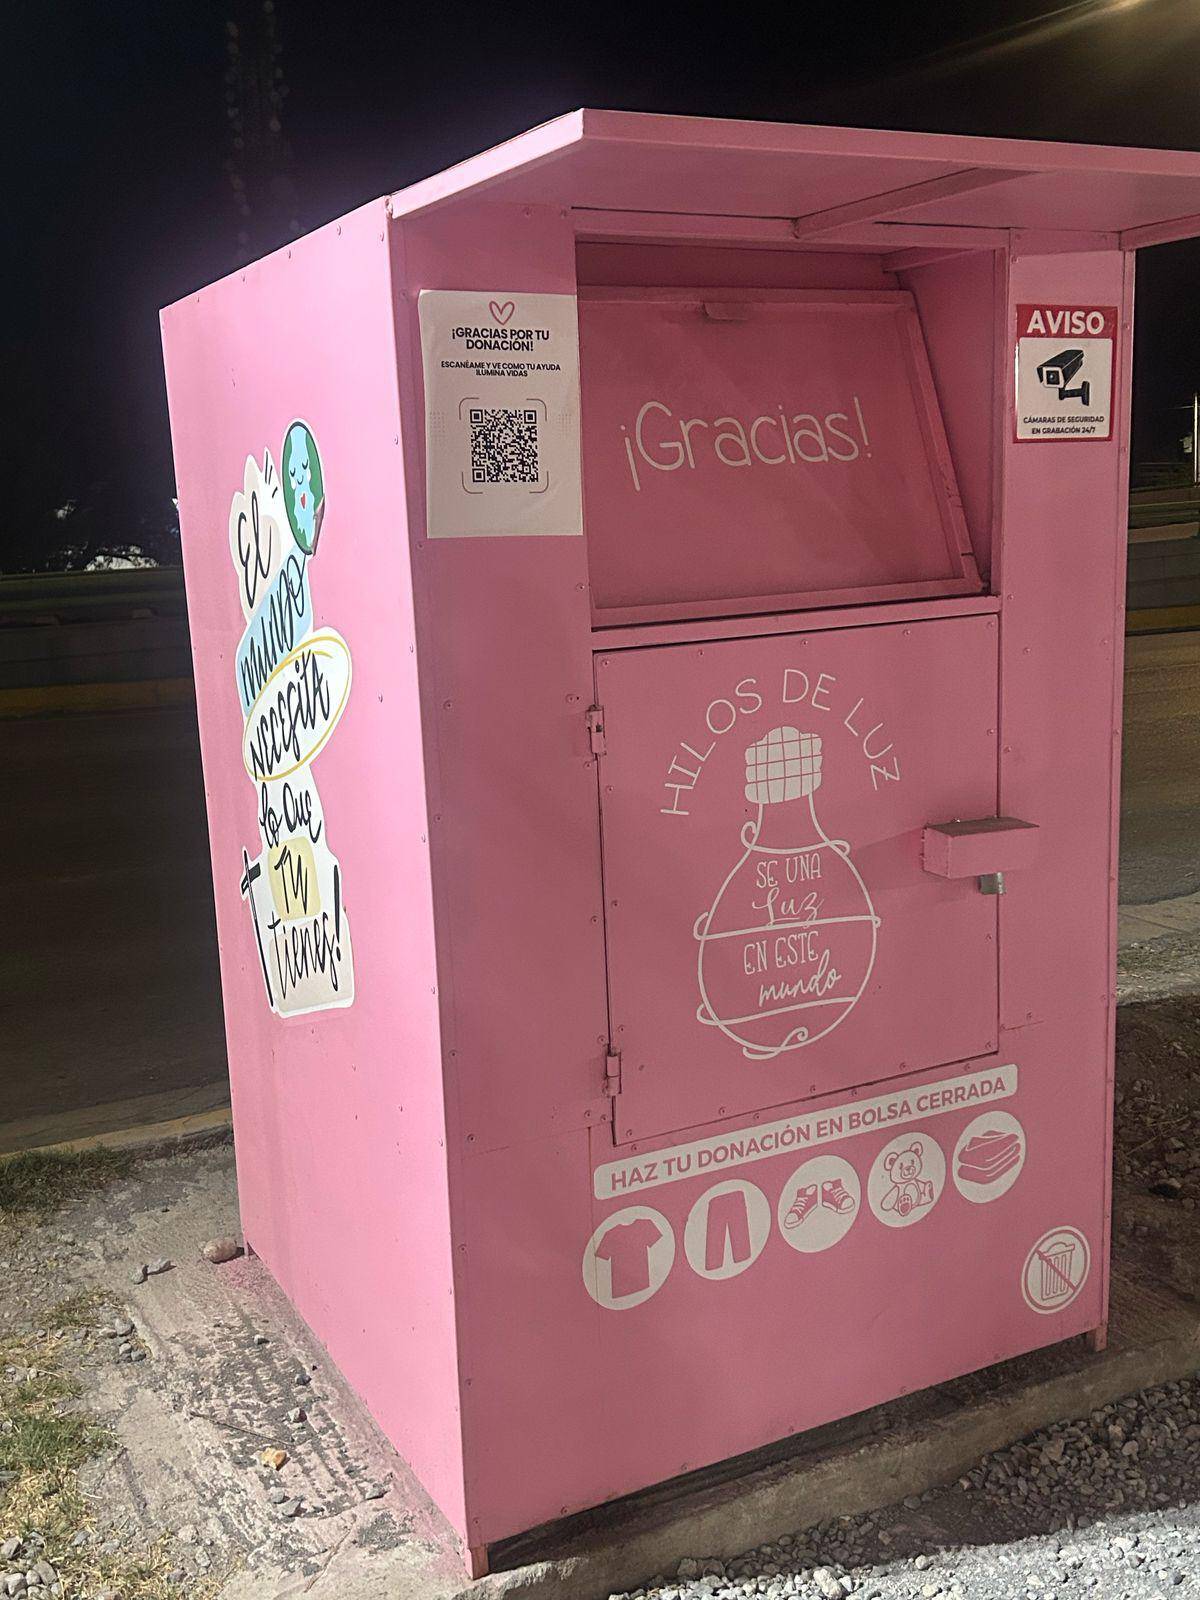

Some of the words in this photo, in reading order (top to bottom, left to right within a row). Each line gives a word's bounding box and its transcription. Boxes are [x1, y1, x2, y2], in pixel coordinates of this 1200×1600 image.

[452, 327, 508, 340] ¡GRACIAS
[510, 329, 533, 341] POR
[535, 330, 550, 341] TU
[1027, 310, 1105, 335] AVISO
[466, 338, 534, 351] DONACIÓN!
[492, 362, 501, 370] VE
[502, 362, 525, 370] COMO
[526, 363, 536, 371] TU
[536, 363, 561, 371] AYUDA
[1023, 415, 1056, 424] CÁMARAS
[1042, 426, 1080, 435] GRABACIÓN
[1081, 426, 1096, 434] 24/7
[620, 397, 872, 491] ¡Gracias!
[660, 678, 763, 815] HILOS
[782, 668, 836, 711] DE
[844, 697, 901, 791] LUZ
[756, 860, 778, 888] SE
[786, 852, 822, 883] UNA
[743, 940, 767, 975] EN
[775, 930, 819, 969] ESTE
[758, 949, 842, 1007] mundo
[611, 1162, 658, 1191] HAZ
[663, 1153, 692, 1176] TU
[697, 1124, 811, 1168] DONACIÓN
[816, 1116, 843, 1138] EN
[849, 1099, 912, 1130] BOLSA
[916, 1076, 1007, 1112] CERRADA
